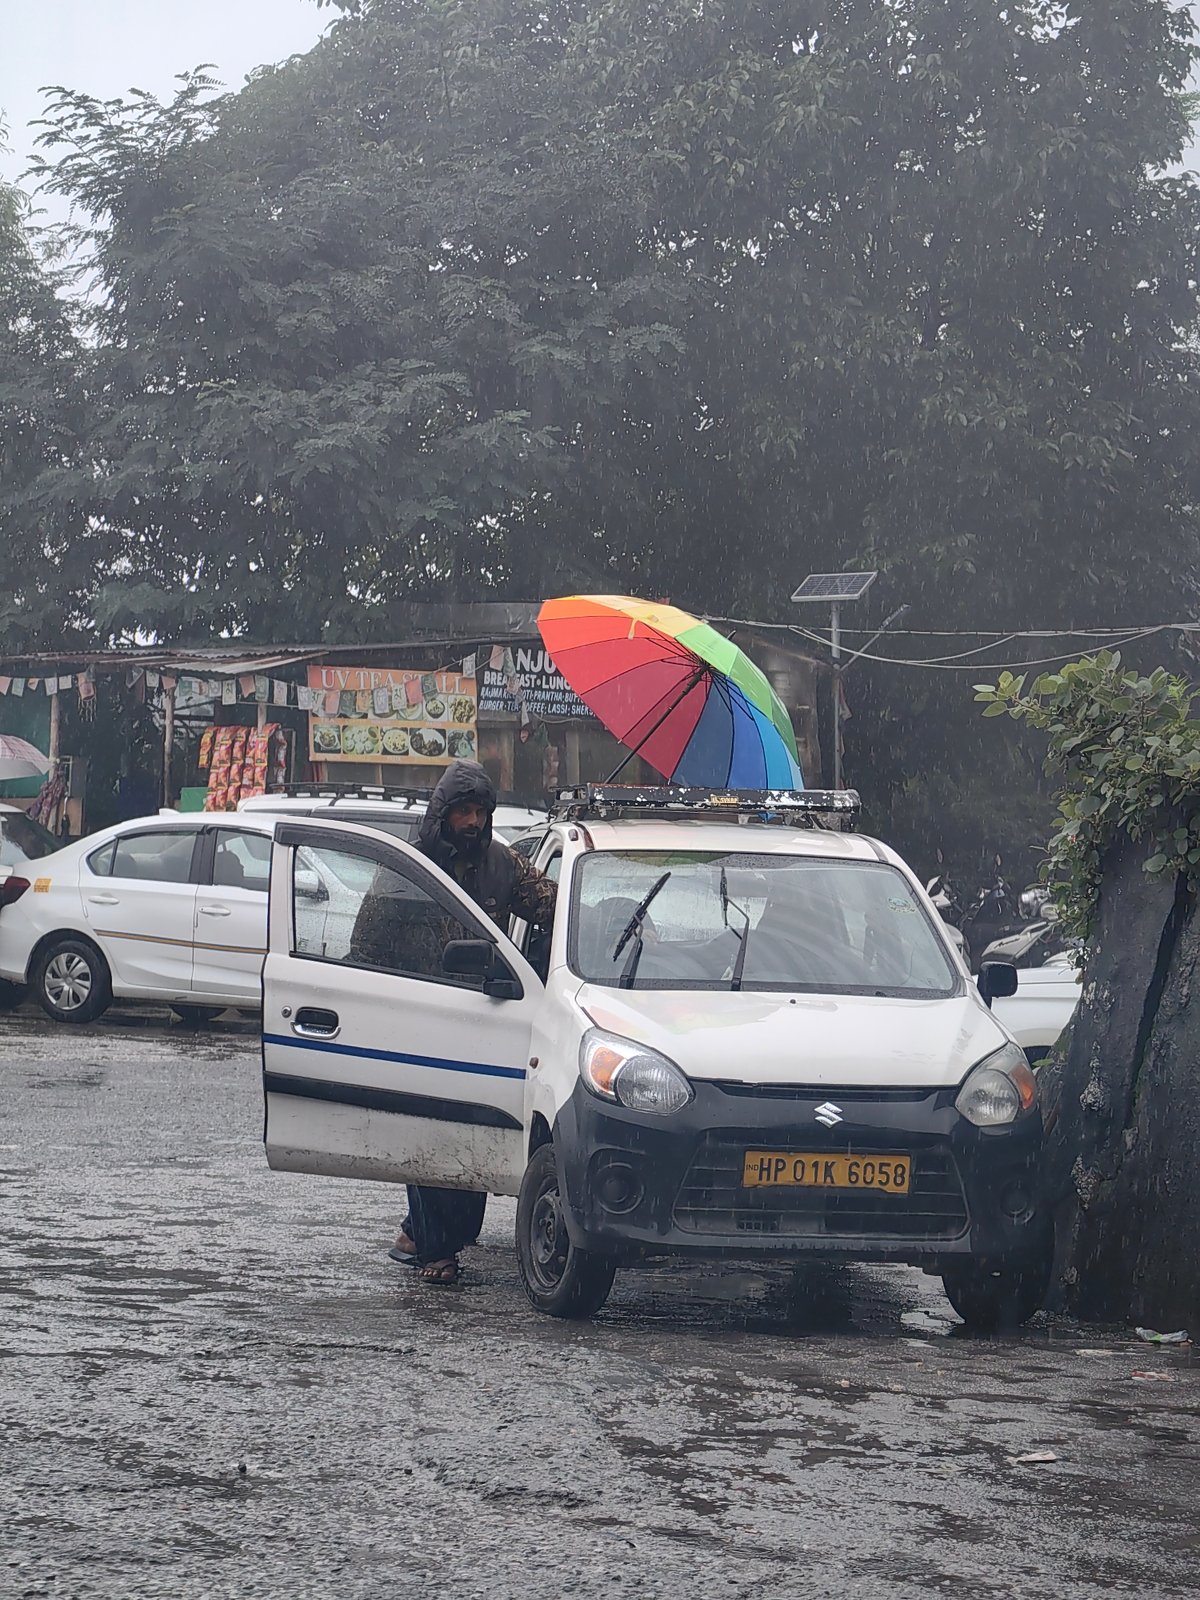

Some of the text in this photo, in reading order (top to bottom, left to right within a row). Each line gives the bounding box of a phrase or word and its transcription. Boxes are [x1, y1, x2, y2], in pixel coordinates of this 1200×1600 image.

[321, 669, 350, 688] UV
[356, 672, 394, 690] TEA
[484, 671, 574, 690] BREAFAST LUNC
[758, 1157, 787, 1182] HP
[848, 1161, 906, 1187] 6058
